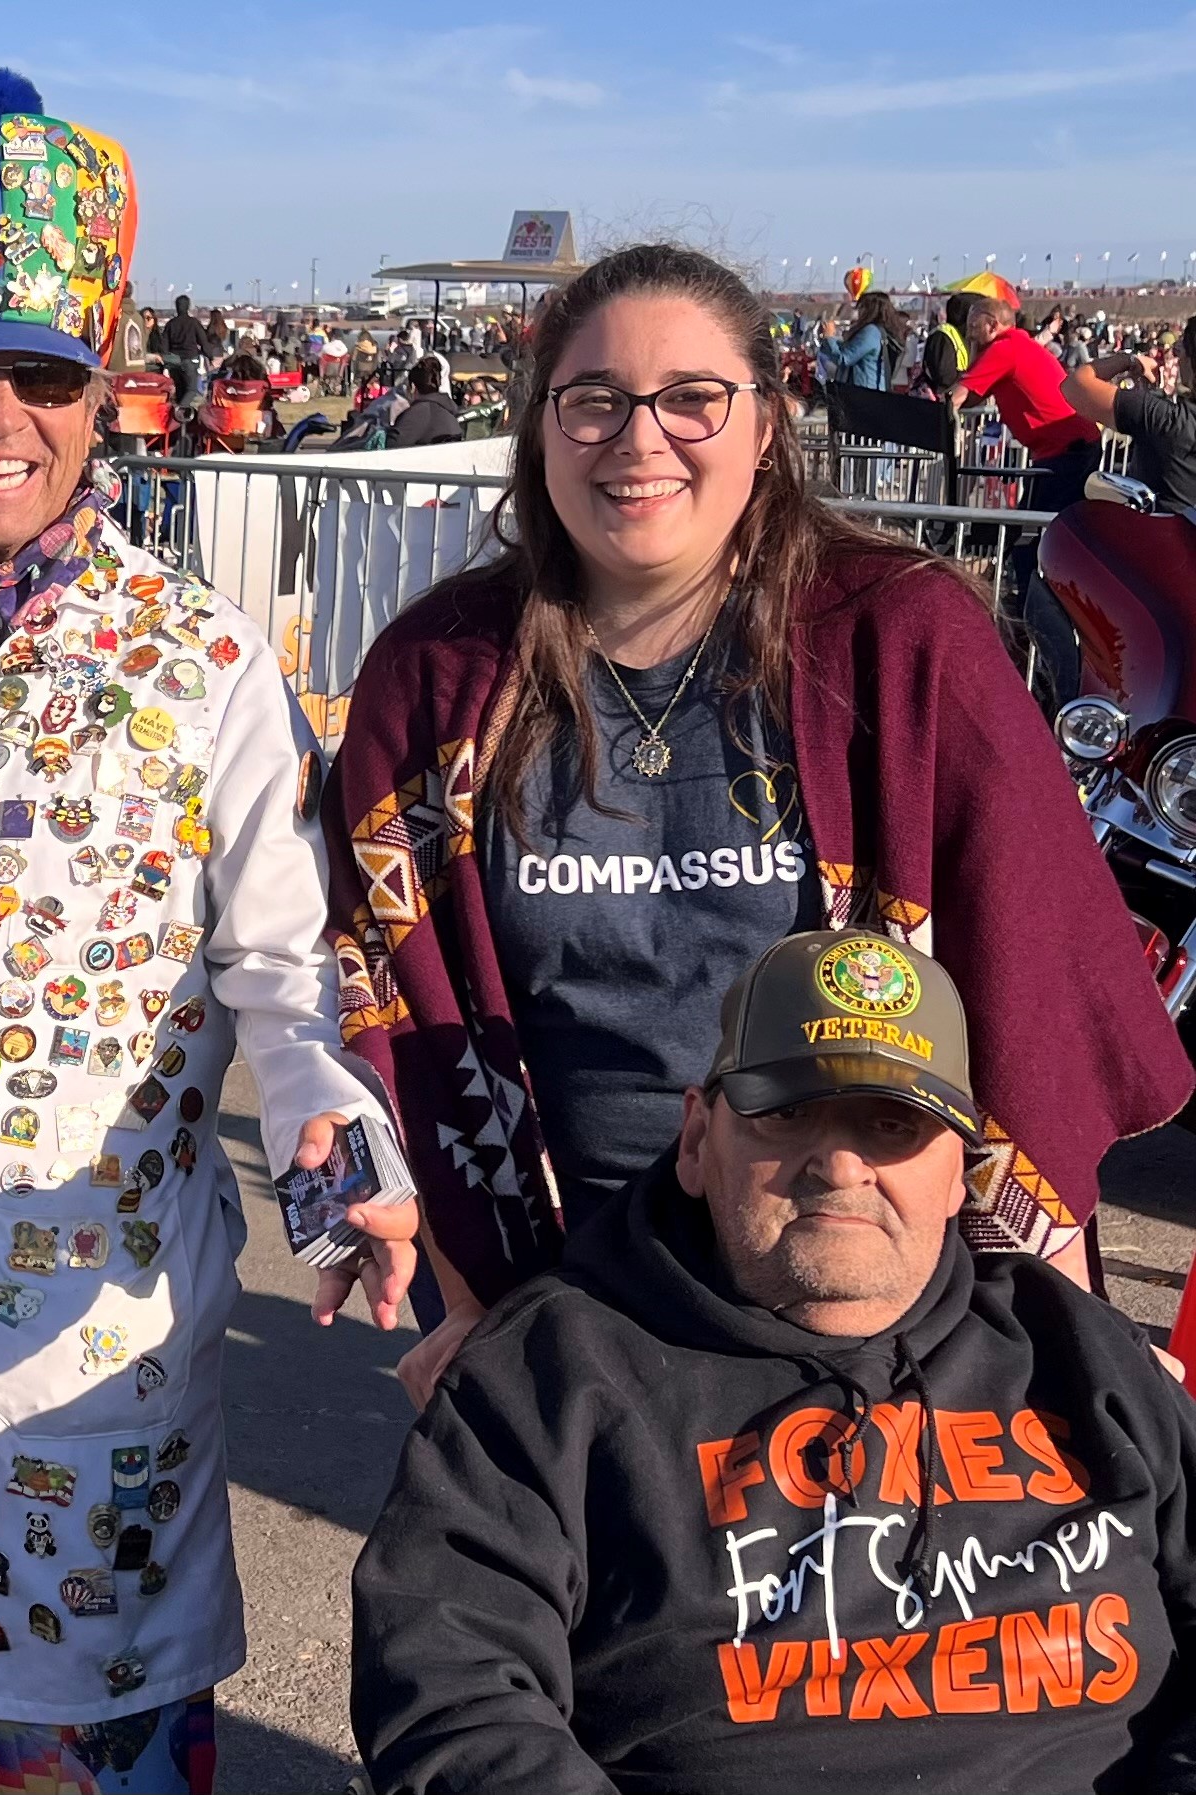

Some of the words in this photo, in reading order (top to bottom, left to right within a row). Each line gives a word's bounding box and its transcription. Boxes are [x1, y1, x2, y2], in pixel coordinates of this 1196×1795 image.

[512, 236, 552, 248] FIESTA
[139, 715, 169, 735] HAVE
[518, 840, 806, 895] COMPASSUS
[849, 1000, 896, 1012] ARMY
[800, 1017, 934, 1062] VETERAN
[286, 1202, 301, 1230] KOB
[291, 1230, 308, 1244] 4
[697, 1401, 1092, 1528] FOXES
[724, 1492, 889, 1659] Fort
[717, 1592, 1139, 1724] VIXENS
